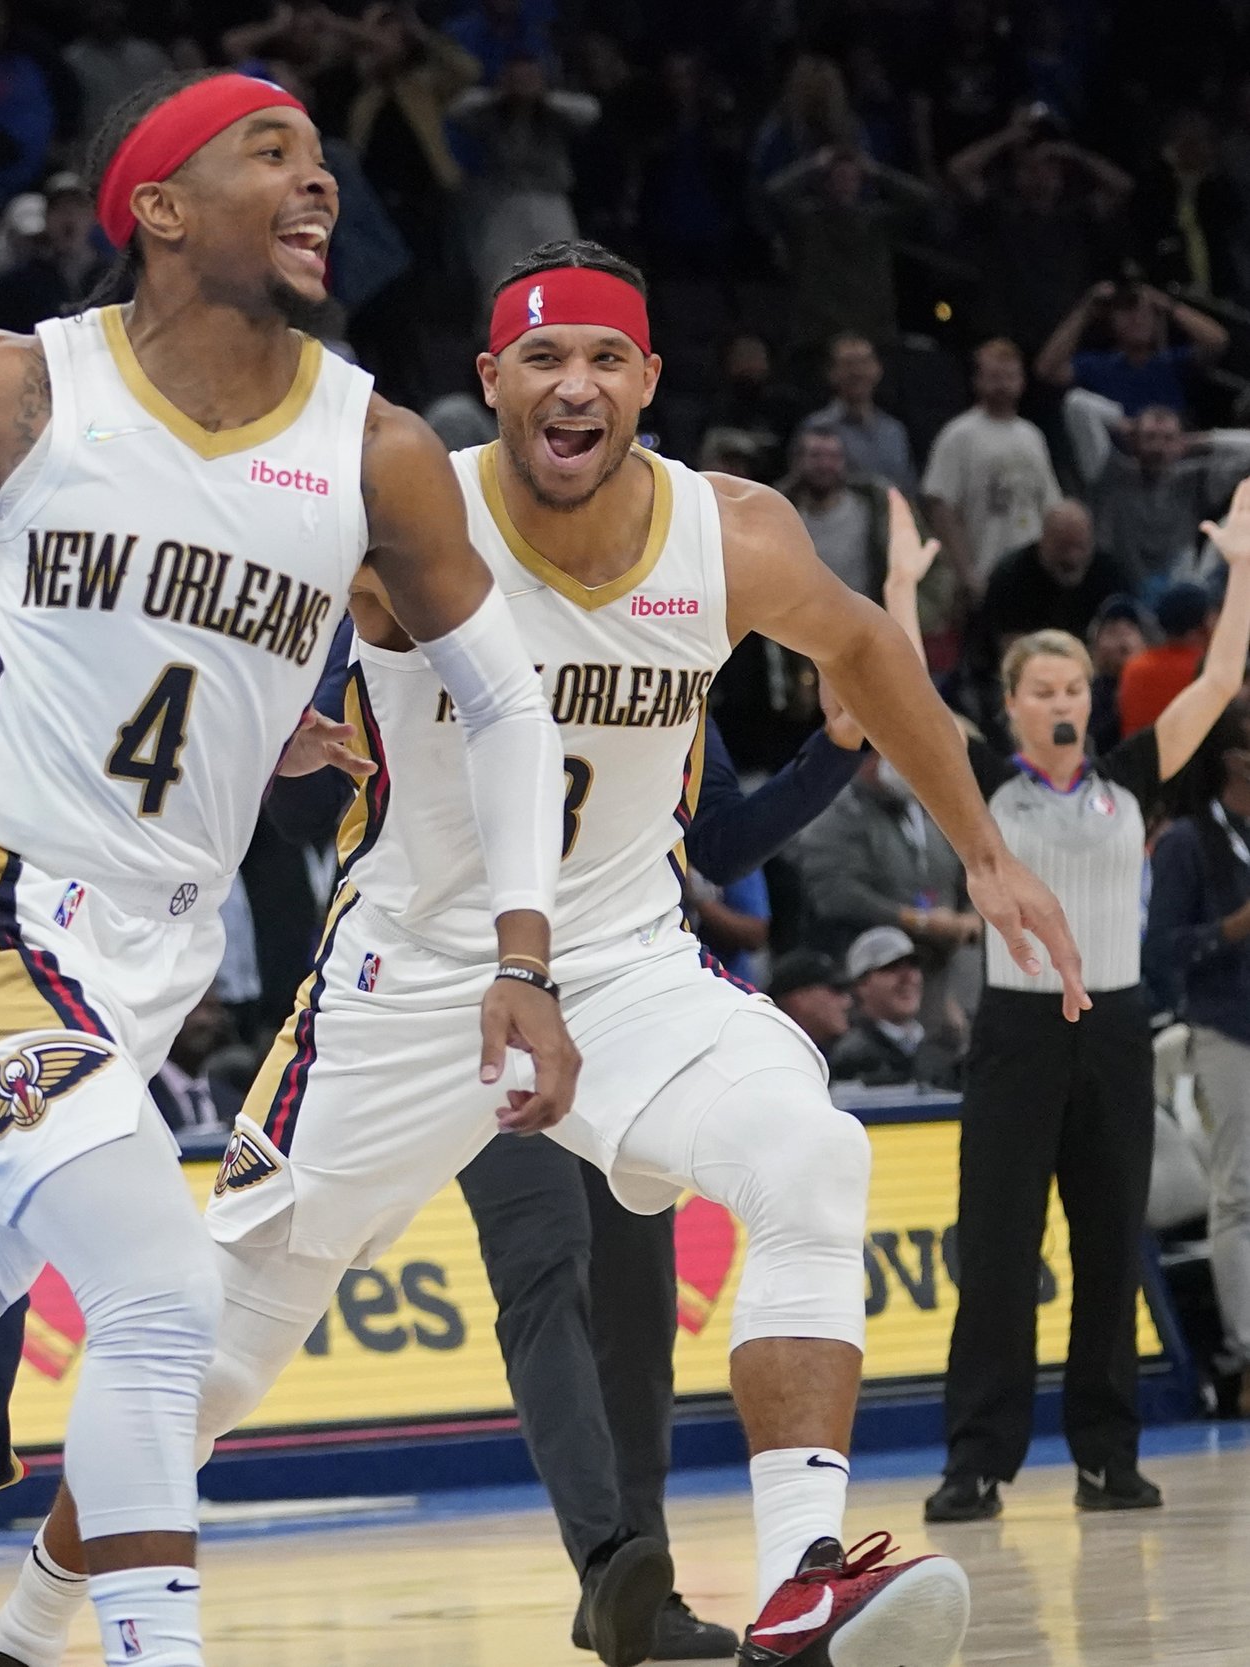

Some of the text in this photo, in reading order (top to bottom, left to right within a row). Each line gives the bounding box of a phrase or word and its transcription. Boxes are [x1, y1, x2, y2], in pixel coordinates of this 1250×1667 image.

[251, 459, 329, 495] ibotta
[22, 529, 332, 667] NEW ORLEANS
[631, 596, 699, 616] ibotta
[552, 663, 712, 727] ORLEANS
[104, 661, 199, 818] 4
